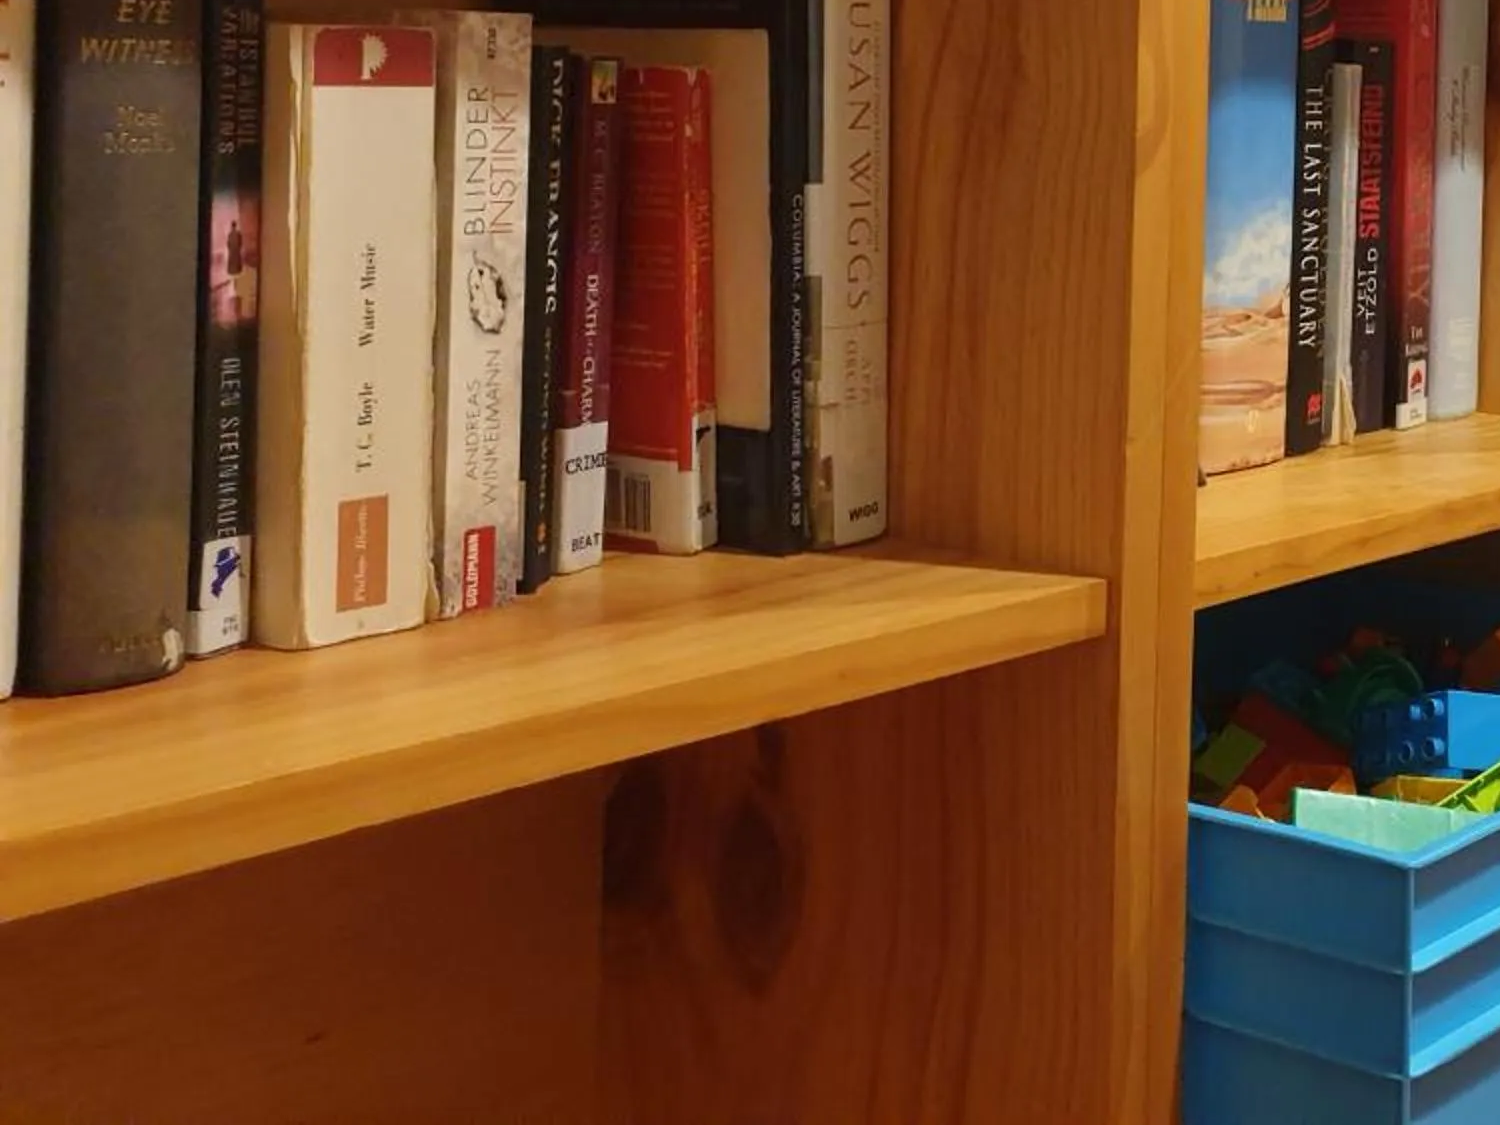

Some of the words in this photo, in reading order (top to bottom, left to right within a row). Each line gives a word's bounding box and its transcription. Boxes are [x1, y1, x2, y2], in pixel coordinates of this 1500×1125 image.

[237, 38, 260, 147] ISTANBUL
[1304, 85, 1324, 131] THE
[462, 86, 489, 236] BLINDER
[488, 84, 518, 235] INSTINKT
[1302, 143, 1323, 197] LAST
[1357, 83, 1383, 240] STAATSFEIND
[359, 243, 378, 291] Music
[846, 150, 873, 311] WIGGS
[585, 273, 600, 336] DEATH
[1297, 207, 1322, 348] SANCTUARY
[1355, 266, 1367, 317] VEIT
[1364, 246, 1379, 335] ETZOLD
[357, 298, 376, 348] Water
[790, 306, 802, 365] JOURNAL
[218, 356, 243, 407] OLEN
[356, 382, 379, 427] Boyle
[464, 378, 482, 481] ANDREAS
[481, 348, 503, 507] WINKELMANN
[464, 533, 480, 608] GOLDMANN
